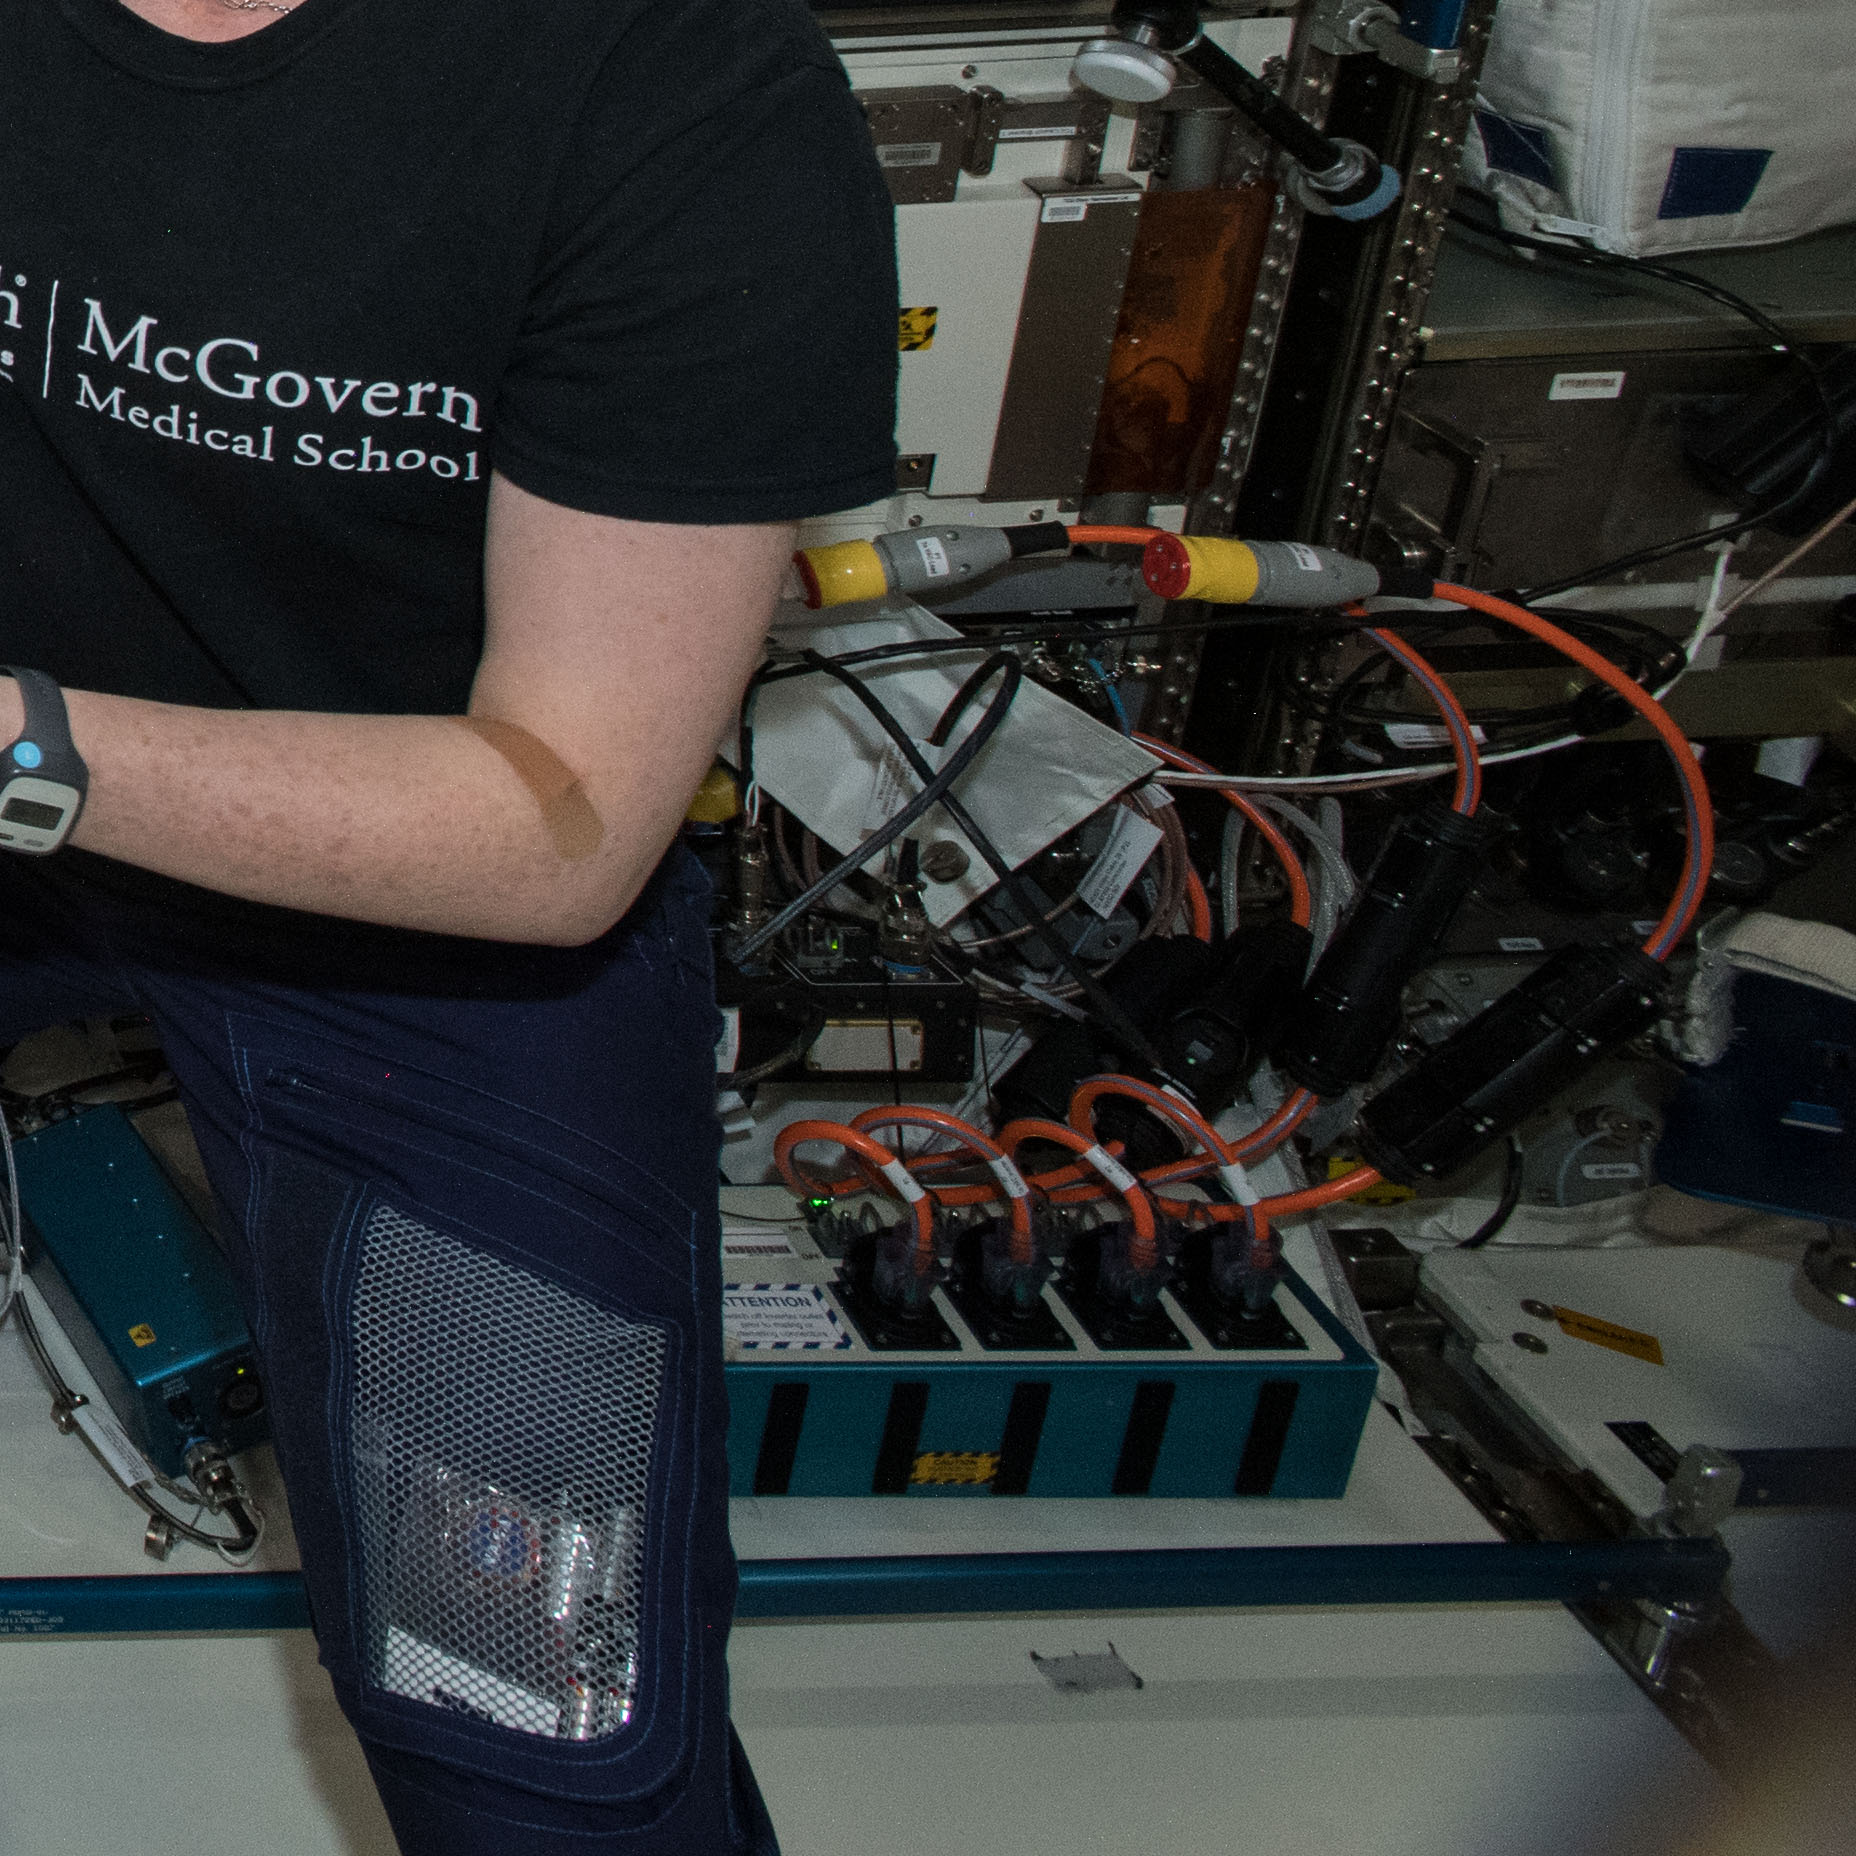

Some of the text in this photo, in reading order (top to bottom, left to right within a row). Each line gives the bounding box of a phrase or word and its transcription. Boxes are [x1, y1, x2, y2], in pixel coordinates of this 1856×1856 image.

[77, 297, 483, 433] McGovern
[75, 373, 480, 481] Medical School
[723, 1296, 812, 1309] ATTENTION
